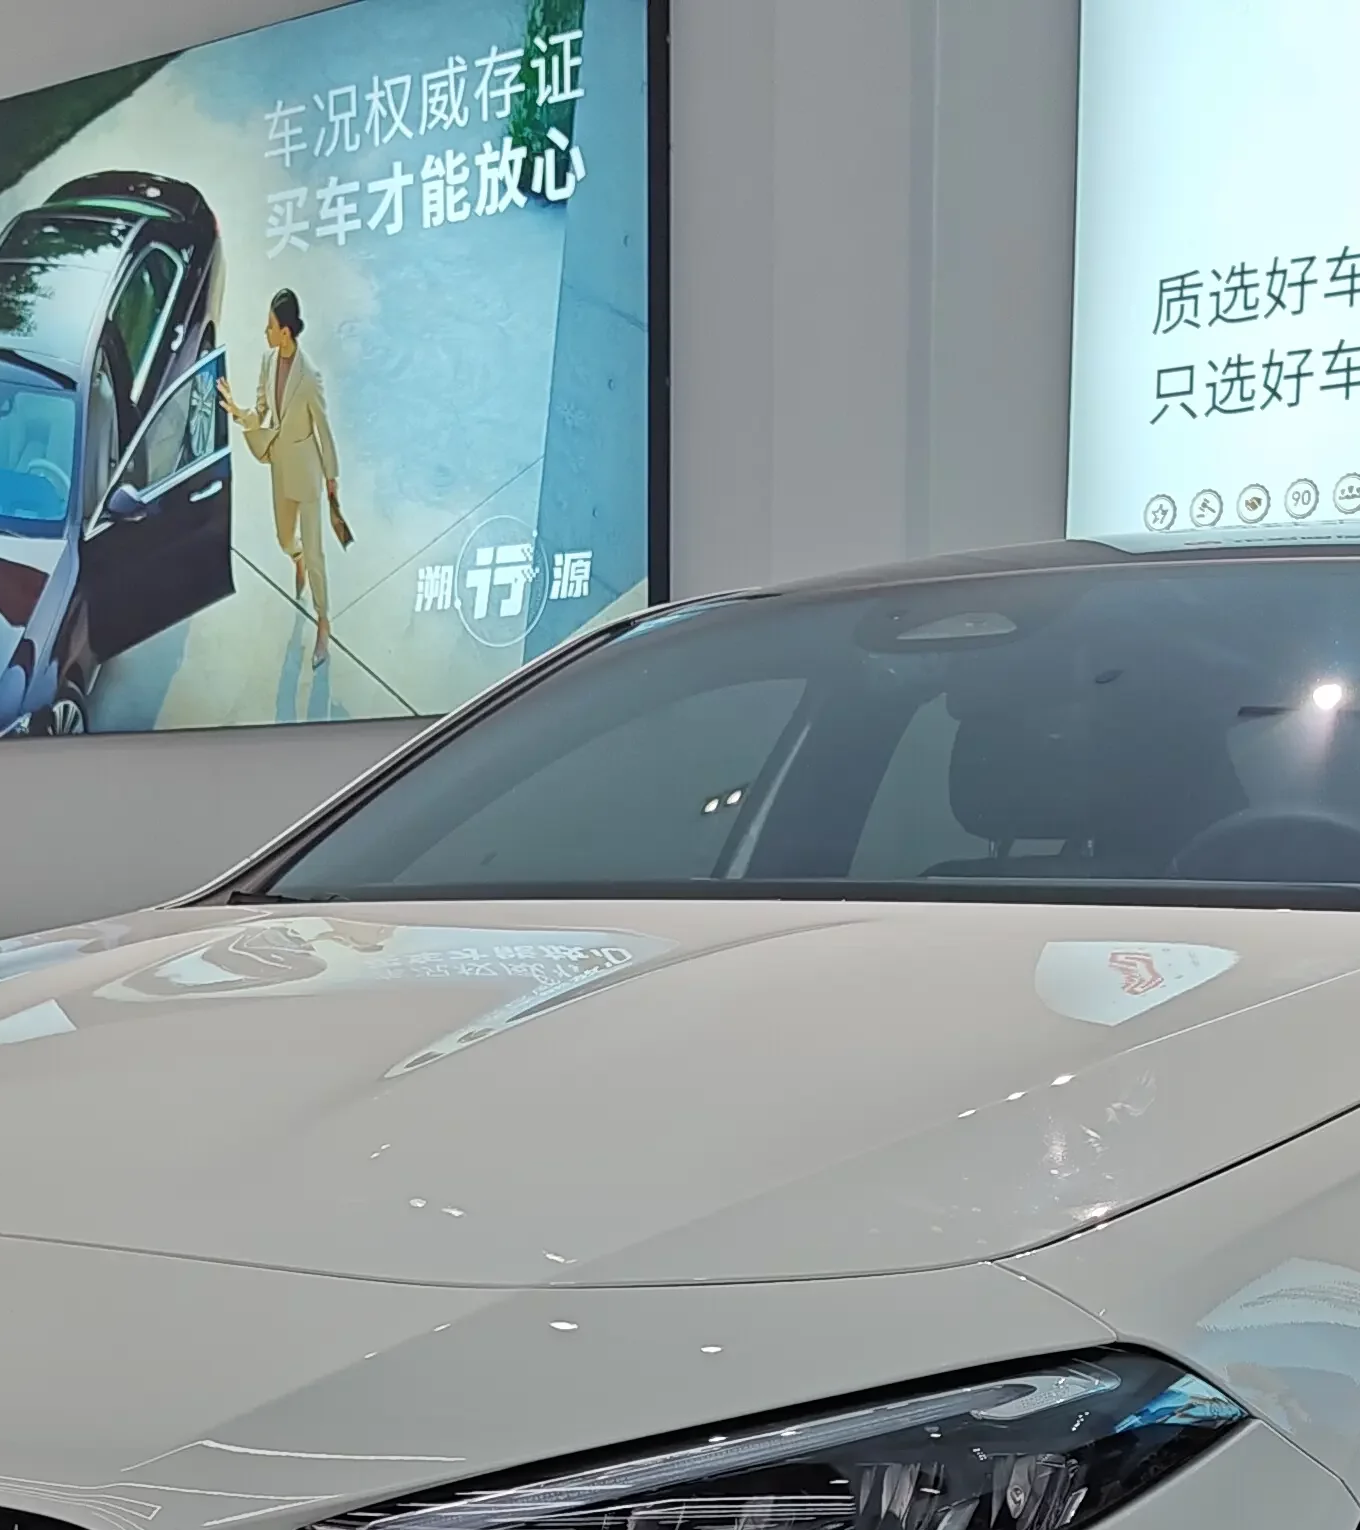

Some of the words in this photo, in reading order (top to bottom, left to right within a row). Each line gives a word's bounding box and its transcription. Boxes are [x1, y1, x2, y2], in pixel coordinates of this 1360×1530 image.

[263, 29, 585, 167] 车况权威存证
[266, 126, 586, 260] 买车才能放心
